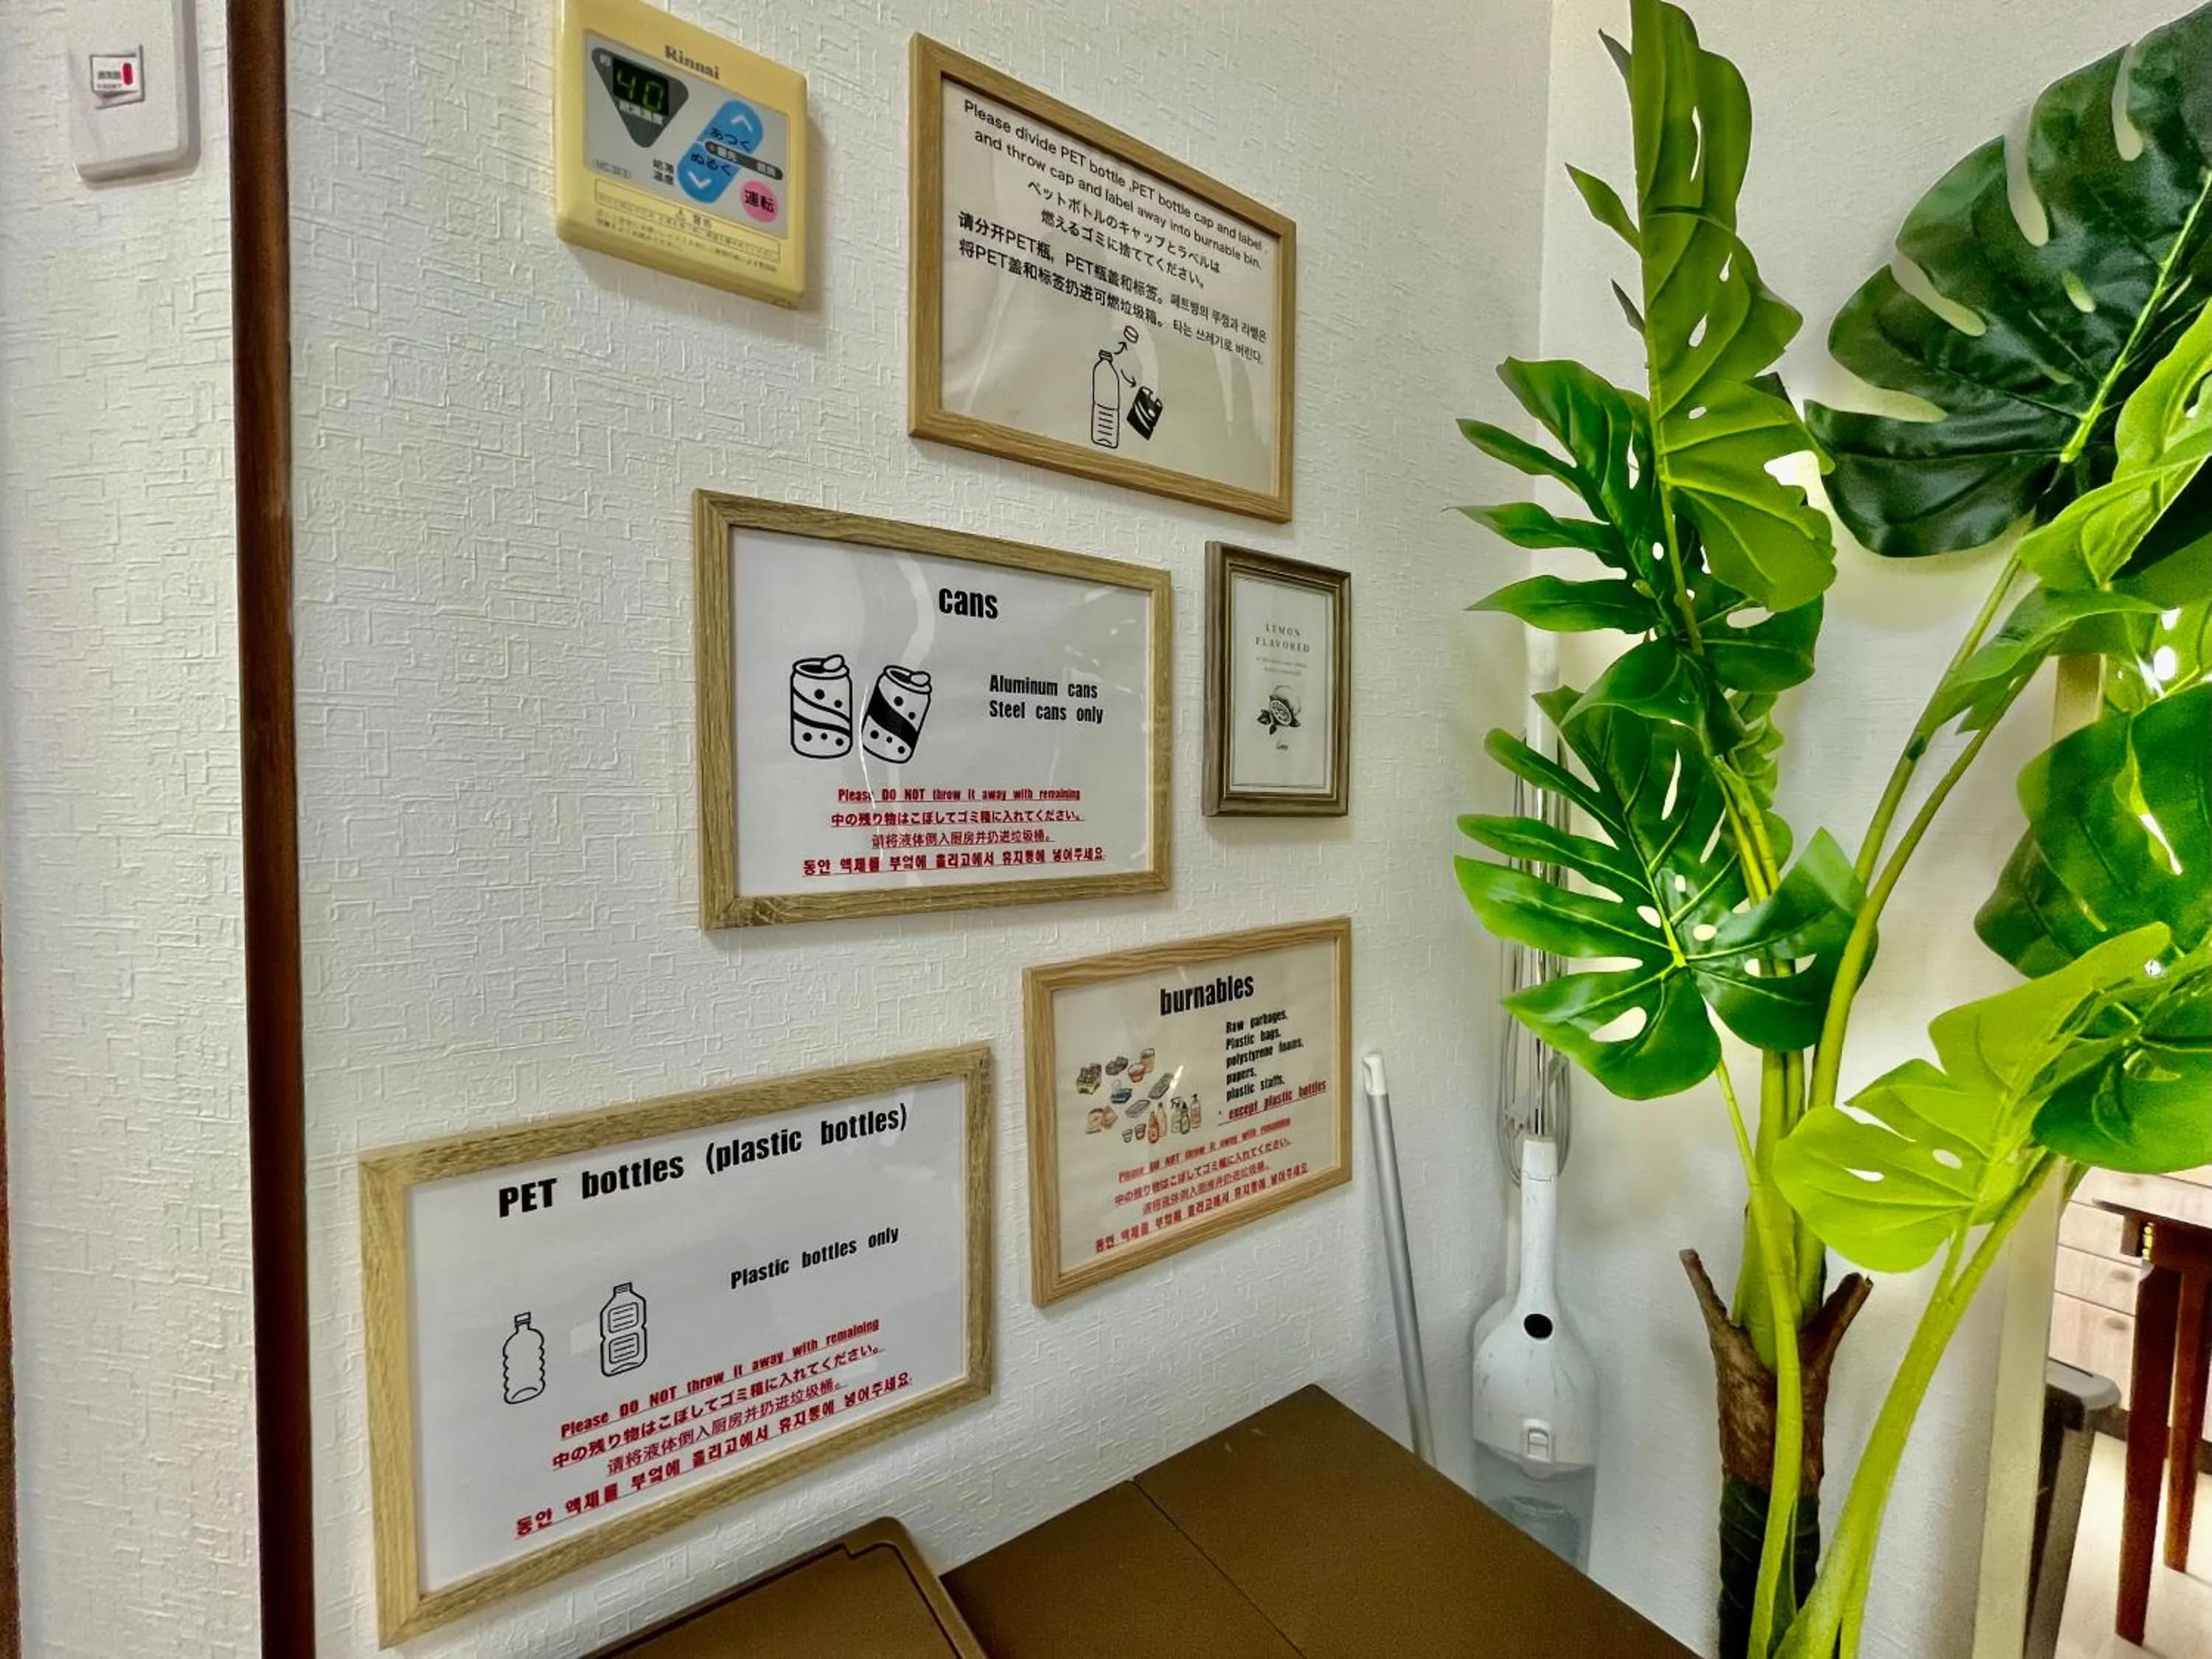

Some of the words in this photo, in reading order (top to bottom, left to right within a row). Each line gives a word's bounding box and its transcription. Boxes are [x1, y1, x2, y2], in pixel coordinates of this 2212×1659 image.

[664, 44, 720, 80] Rinnai
[616, 69, 664, 112] 40
[964, 99, 1012, 133] Please
[1015, 126, 1057, 154] divide
[1060, 145, 1086, 167] PET
[1089, 159, 1126, 187] bottle
[1158, 192, 1191, 218] bottle
[1194, 212, 1214, 229] cap
[1217, 222, 1237, 239] and
[743, 188, 775, 213] 運転
[974, 129, 1002, 151] and
[1006, 144, 1046, 172] throw
[1049, 166, 1075, 186] cap
[1077, 178, 1102, 197] and
[1105, 188, 1134, 212] label
[1136, 205, 1167, 229] away
[1170, 218, 1192, 238] into
[1193, 229, 1242, 261] burnable
[1027, 181, 1221, 274] ペットボトルのキャップとラベルは
[1040, 208, 1204, 289] 燃えるゴミに捨ててください。
[1173, 319, 1193, 338] 타는
[938, 588, 999, 619] cans
[1256, 636, 1310, 653] FLAVORED
[1265, 623, 1301, 636] LEMON
[989, 674, 1059, 697] Aluminum
[1068, 681, 1099, 699] cans
[989, 700, 1026, 719] Steel
[1035, 703, 1067, 721] cans
[1077, 706, 1104, 725] only
[882, 788, 897, 801] DO
[905, 788, 926, 801] NOT
[933, 788, 961, 801] throw
[982, 790, 1007, 801] away
[1013, 787, 1033, 800] with
[803, 859, 831, 875] 동안
[1160, 974, 1254, 1016] burnables
[1225, 1020, 1244, 1034] Raw
[1225, 1034, 1255, 1050] Plastic
[1225, 1046, 1273, 1069] polystyrene
[1226, 1083, 1255, 1102] plastic
[1228, 1100, 1258, 1119] except
[1263, 1090, 1293, 1111] plastic
[1298, 1080, 1326, 1097] bottles
[498, 1178, 557, 1218] PET
[581, 1155, 684, 1200] bottles
[705, 1127, 803, 1175] (plastic
[821, 1102, 908, 1147] bottles)
[730, 1256, 790, 1290] Plastic
[801, 1237, 857, 1269] bottles
[868, 1226, 900, 1249] only
[560, 1411, 609, 1439] Please
[619, 1399, 639, 1418] DO
[649, 1385, 678, 1408] NOT
[686, 1371, 725, 1394] throw
[733, 1363, 742, 1380] it
[751, 1351, 784, 1371] away
[792, 1338, 818, 1357] with
[826, 1318, 880, 1345] remaining
[516, 1508, 553, 1537] 동안
[779, 1399, 835, 1434] 휴지통에
